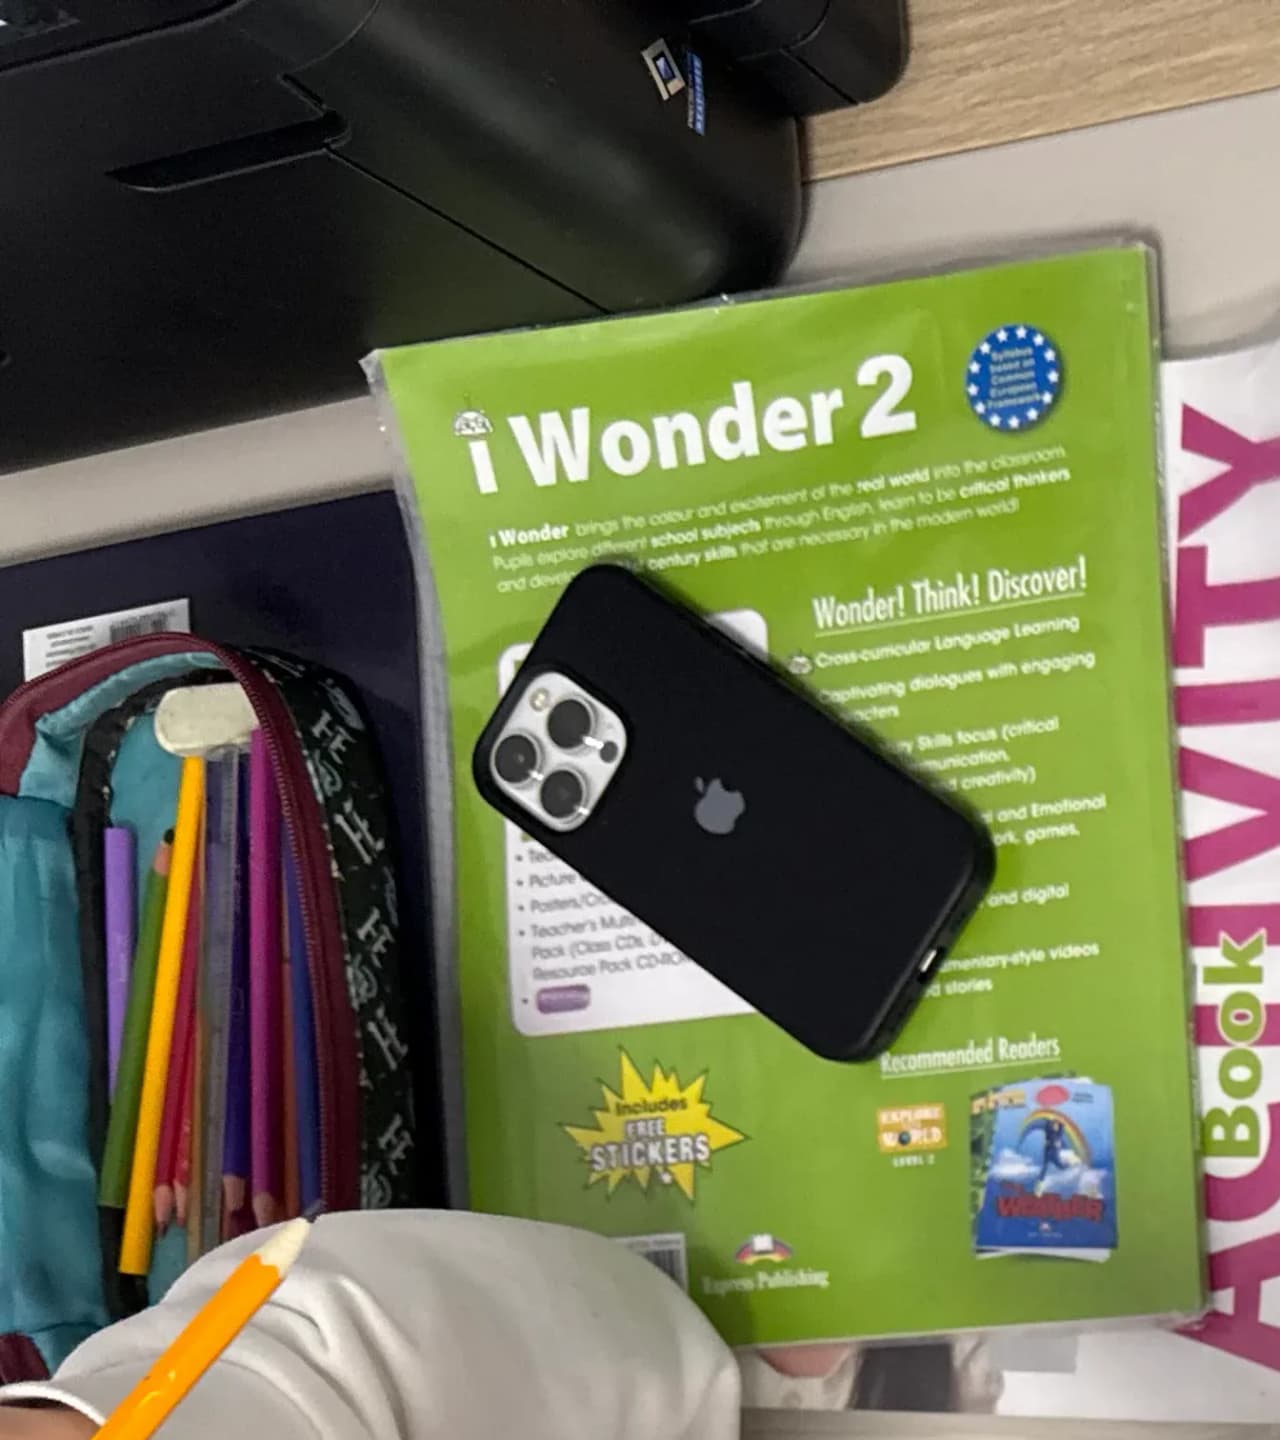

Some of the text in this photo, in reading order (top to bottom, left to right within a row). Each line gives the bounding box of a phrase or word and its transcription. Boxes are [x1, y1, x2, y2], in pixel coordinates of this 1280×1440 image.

[507, 380, 844, 487] Wonder
[857, 354, 917, 439] 2
[499, 523, 569, 547] Wonder
[575, 518, 620, 538] brings
[622, 513, 647, 530] the
[697, 500, 728, 517] and
[730, 489, 809, 514] excitement
[811, 484, 826, 500] of
[828, 480, 854, 496] the
[856, 474, 886, 492] real
[889, 467, 931, 487] world
[933, 464, 961, 481] into
[963, 457, 989, 474] the
[537, 545, 589, 566] explore
[650, 529, 699, 549] school
[701, 519, 761, 544] subjects
[879, 496, 916, 512] learn
[918, 488, 935, 505] to
[936, 485, 957, 501] be
[959, 475, 1010, 500] critical
[1012, 466, 1071, 489] thinkers
[497, 575, 527, 593] and
[649, 551, 701, 573] century
[704, 543, 738, 562] skills
[740, 538, 768, 554] that
[773, 536, 796, 551] are
[799, 524, 871, 547] necessary
[874, 520, 888, 535] in
[890, 515, 914, 531] the
[916, 507, 973, 528] modern
[812, 554, 1088, 630] Wonder! Think! Discover!
[816, 614, 1081, 669] Cross-curricular Language Learning
[819, 651, 1097, 704] Captivating dialogues with engaging
[917, 729, 954, 753] Skills
[956, 726, 998, 746] focus
[1001, 715, 1060, 742] (critical
[960, 766, 1037, 791] creativity)
[995, 805, 1028, 823] and
[1031, 794, 1108, 819] Emotional
[1024, 823, 1081, 846] games,
[986, 883, 1070, 908] and digital
[1048, 940, 1100, 962] videos
[945, 976, 994, 997] stories
[881, 1033, 1061, 1075] Recommended Readers
[1201, 932, 1265, 1158] Book
[616, 1097, 688, 1117] Includes
[625, 1117, 666, 1138] FREE
[591, 1134, 711, 1172] STICKERS
